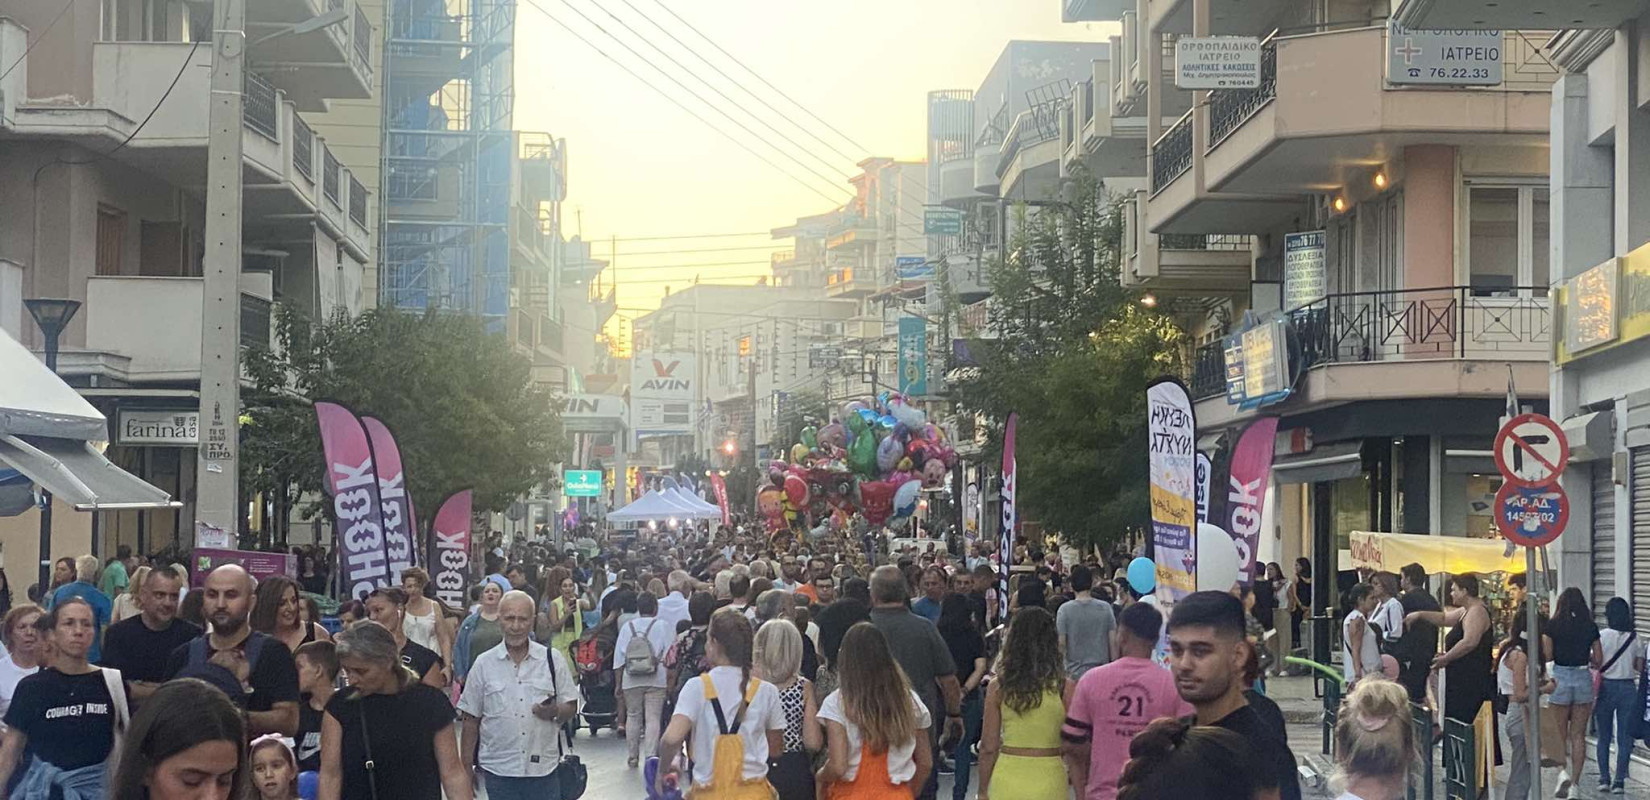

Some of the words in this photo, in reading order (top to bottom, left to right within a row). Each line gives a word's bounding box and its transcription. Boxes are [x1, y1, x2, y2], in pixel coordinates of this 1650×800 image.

[1181, 42, 1257, 51] ΟΡΘΟΠΑΙΔΙΚΟ
[1199, 52, 1241, 61] ΙΑΤΡΕΙΟ
[1441, 47, 1499, 61] ΙΑΤΡΕΙΟ
[1182, 63, 1220, 72] ΑΘΛΗΤΙΚΕΣ
[1222, 63, 1257, 72] ΚΑΚΩΣΕΙΣ
[1430, 67, 1489, 79] 76.22.33
[1288, 251, 1324, 262] ΔΥΣΛΕΞΙΑ
[640, 379, 690, 391] AVIN
[126, 418, 187, 438] farina
[189, 416, 197, 438] casa
[86, 702, 108, 715] INSIDE
[1118, 695, 1143, 717] 21
